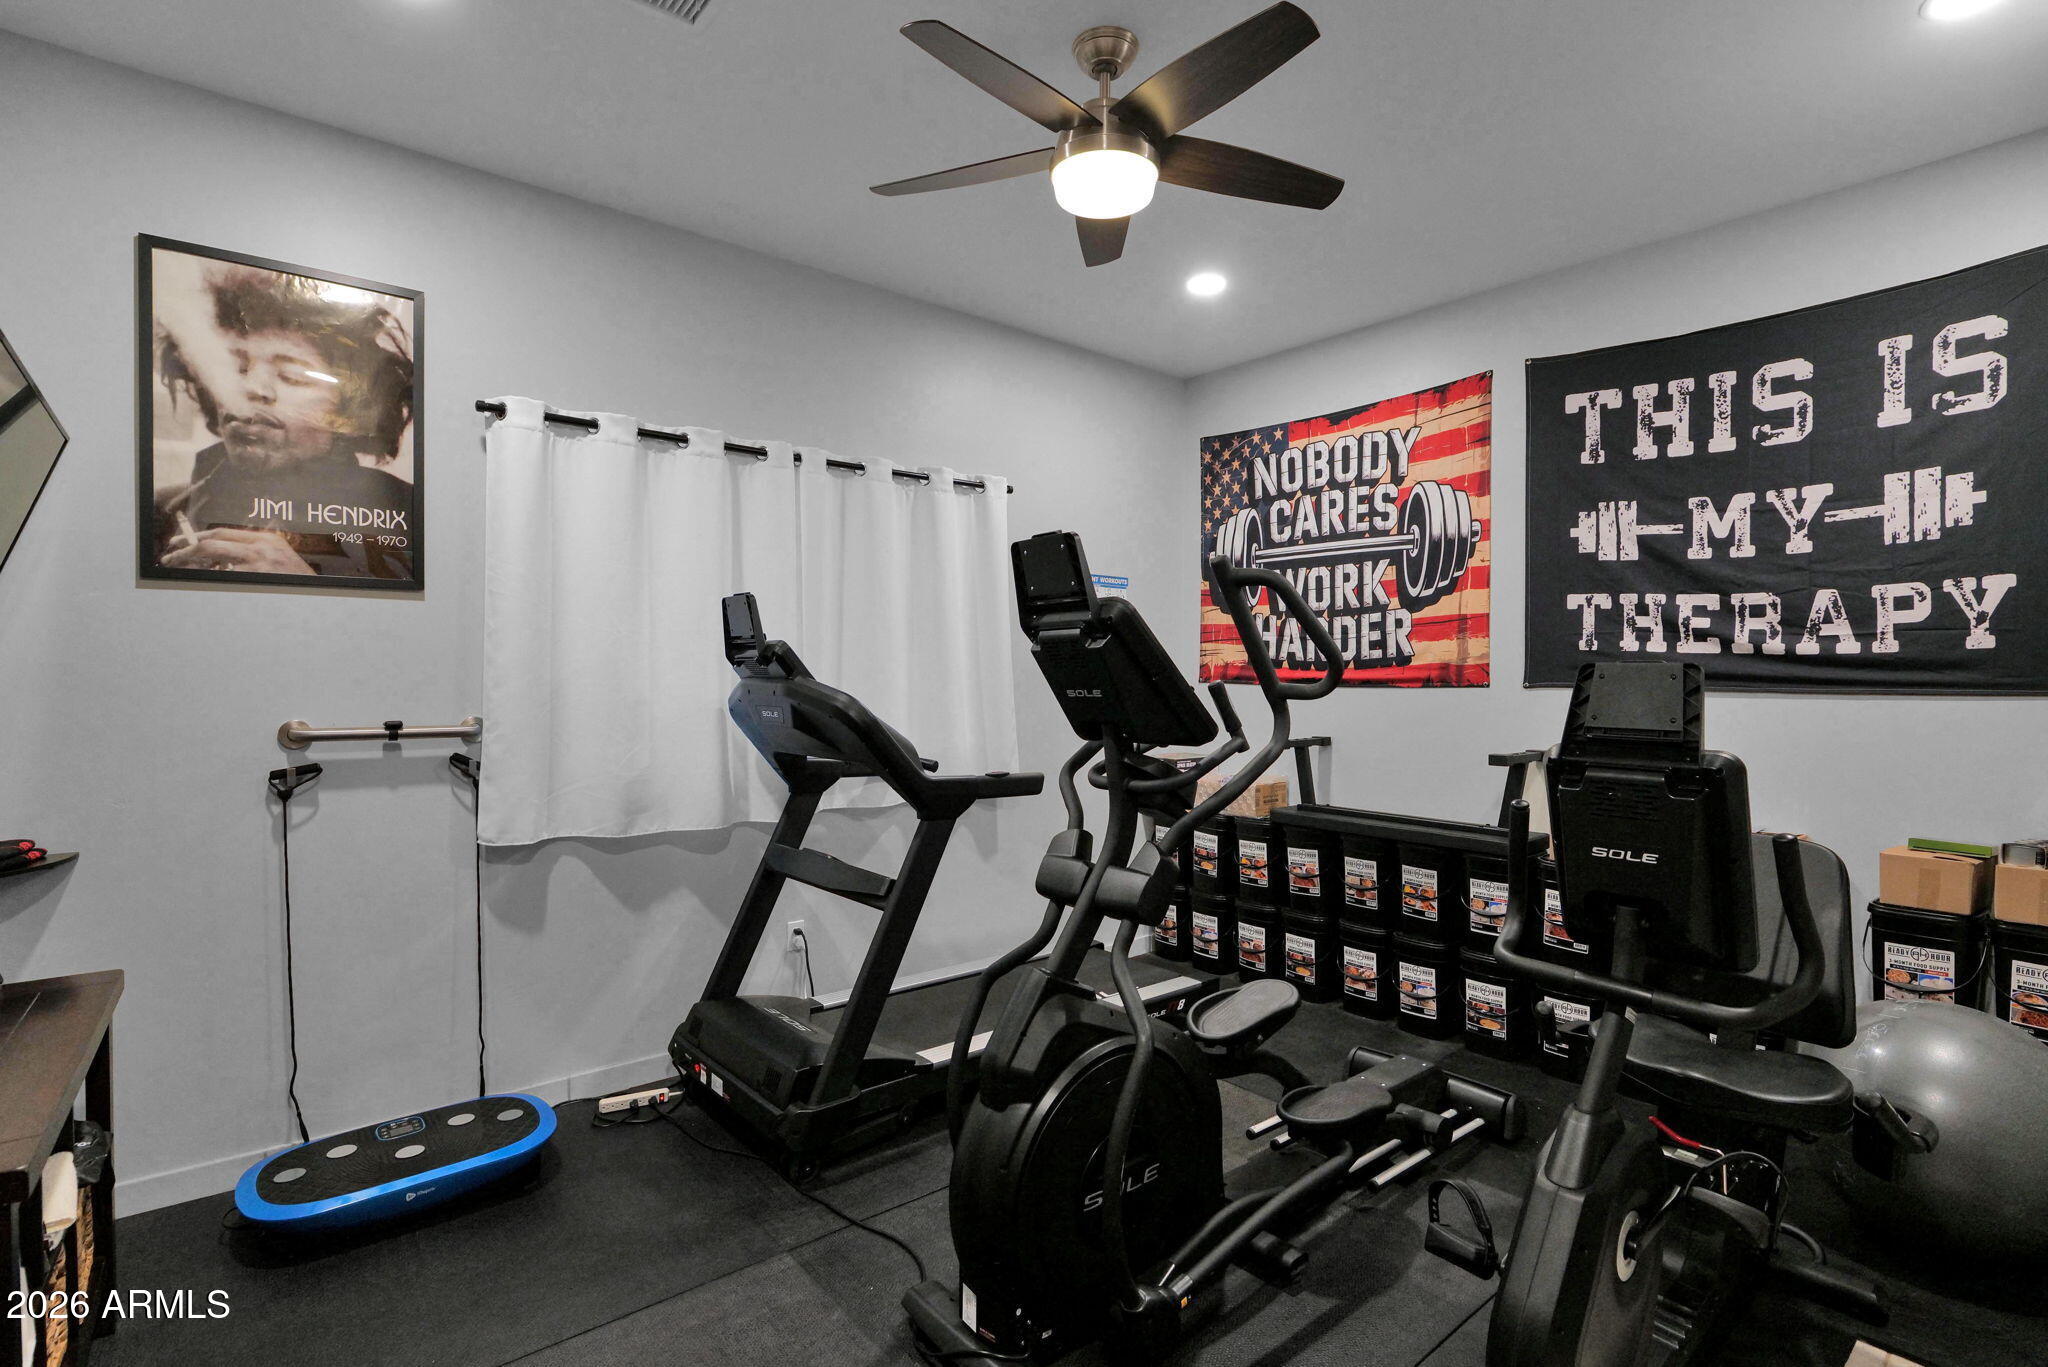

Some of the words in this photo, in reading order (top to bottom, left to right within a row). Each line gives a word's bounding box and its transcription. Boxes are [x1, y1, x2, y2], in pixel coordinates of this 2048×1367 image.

[1565, 357, 1814, 464] THIS
[1876, 314, 2009, 428] IS
[1253, 427, 1422, 500] NOBODY
[248, 497, 293, 521] JIMI
[307, 502, 408, 530] HENDRIX
[1269, 483, 1400, 544] CARES
[1688, 483, 1834, 560] MY
[332, 531, 363, 545] 1942
[376, 535, 408, 547] 1970
[1272, 558, 1391, 611] WORK
[1566, 573, 2018, 655] THERAPY
[1066, 689, 1102, 697] SOLE
[762, 710, 779, 718] SOLE
[1591, 846, 1659, 864] SOLE
[1887, 946, 1910, 956] READY
[1930, 953, 1951, 962] HOUR
[2016, 966, 2041, 977] READY
[1083, 1162, 1160, 1212] SLE
